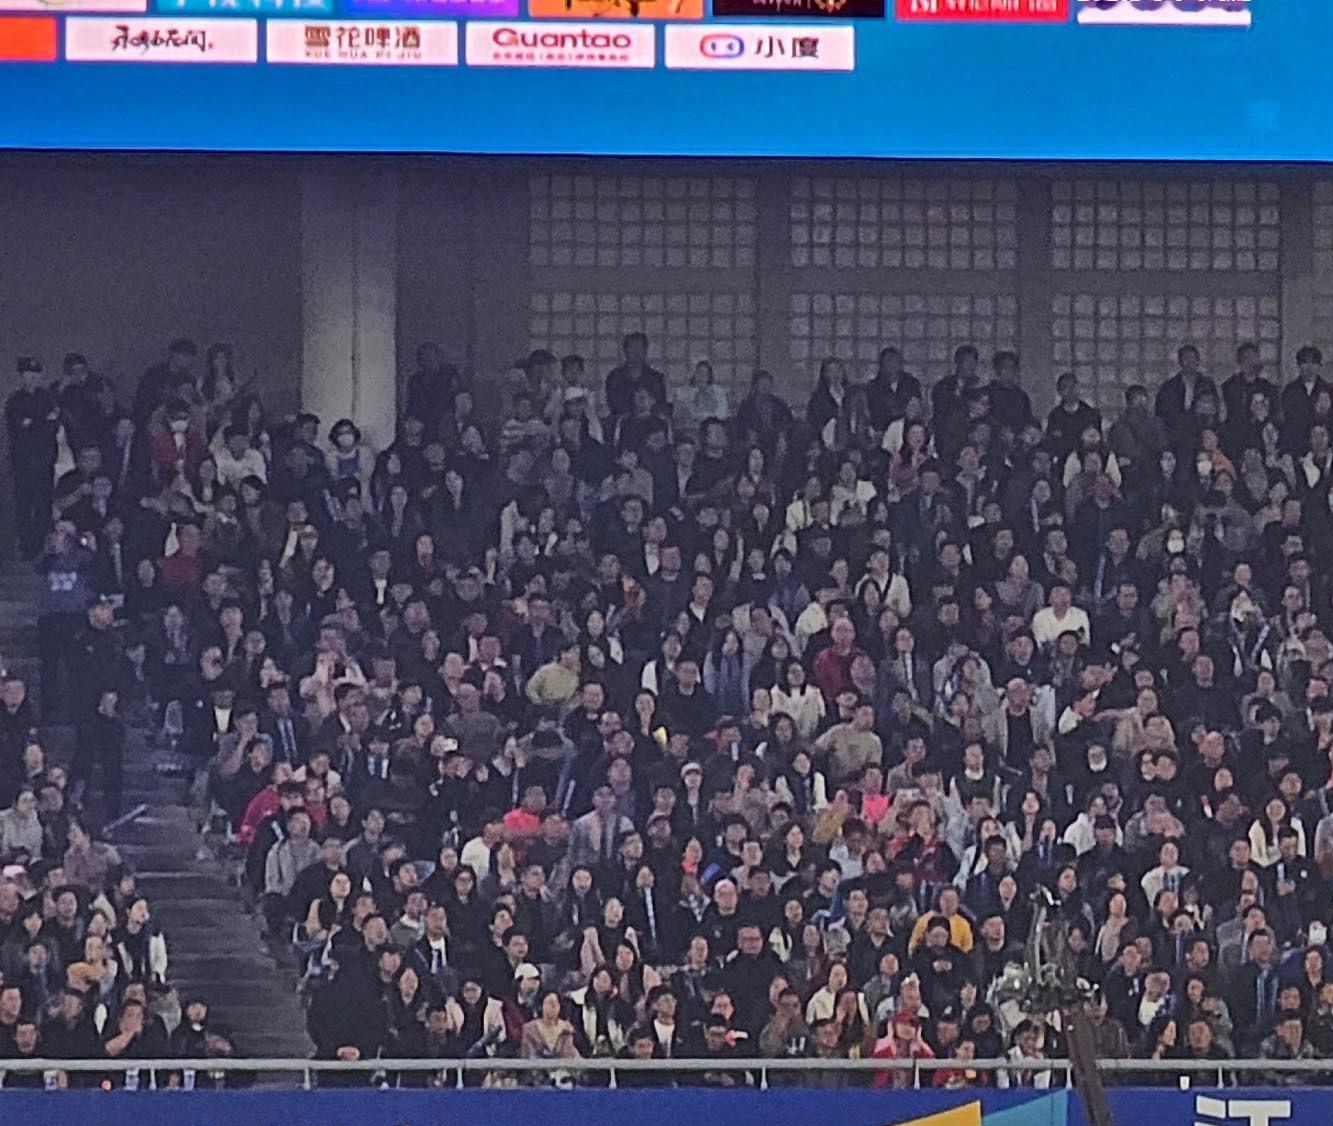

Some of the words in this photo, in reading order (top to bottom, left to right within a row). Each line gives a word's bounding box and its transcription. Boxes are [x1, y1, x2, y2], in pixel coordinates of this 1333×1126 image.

[304, 26, 421, 49] 雪花啤酒
[755, 35, 819, 58] 小度
